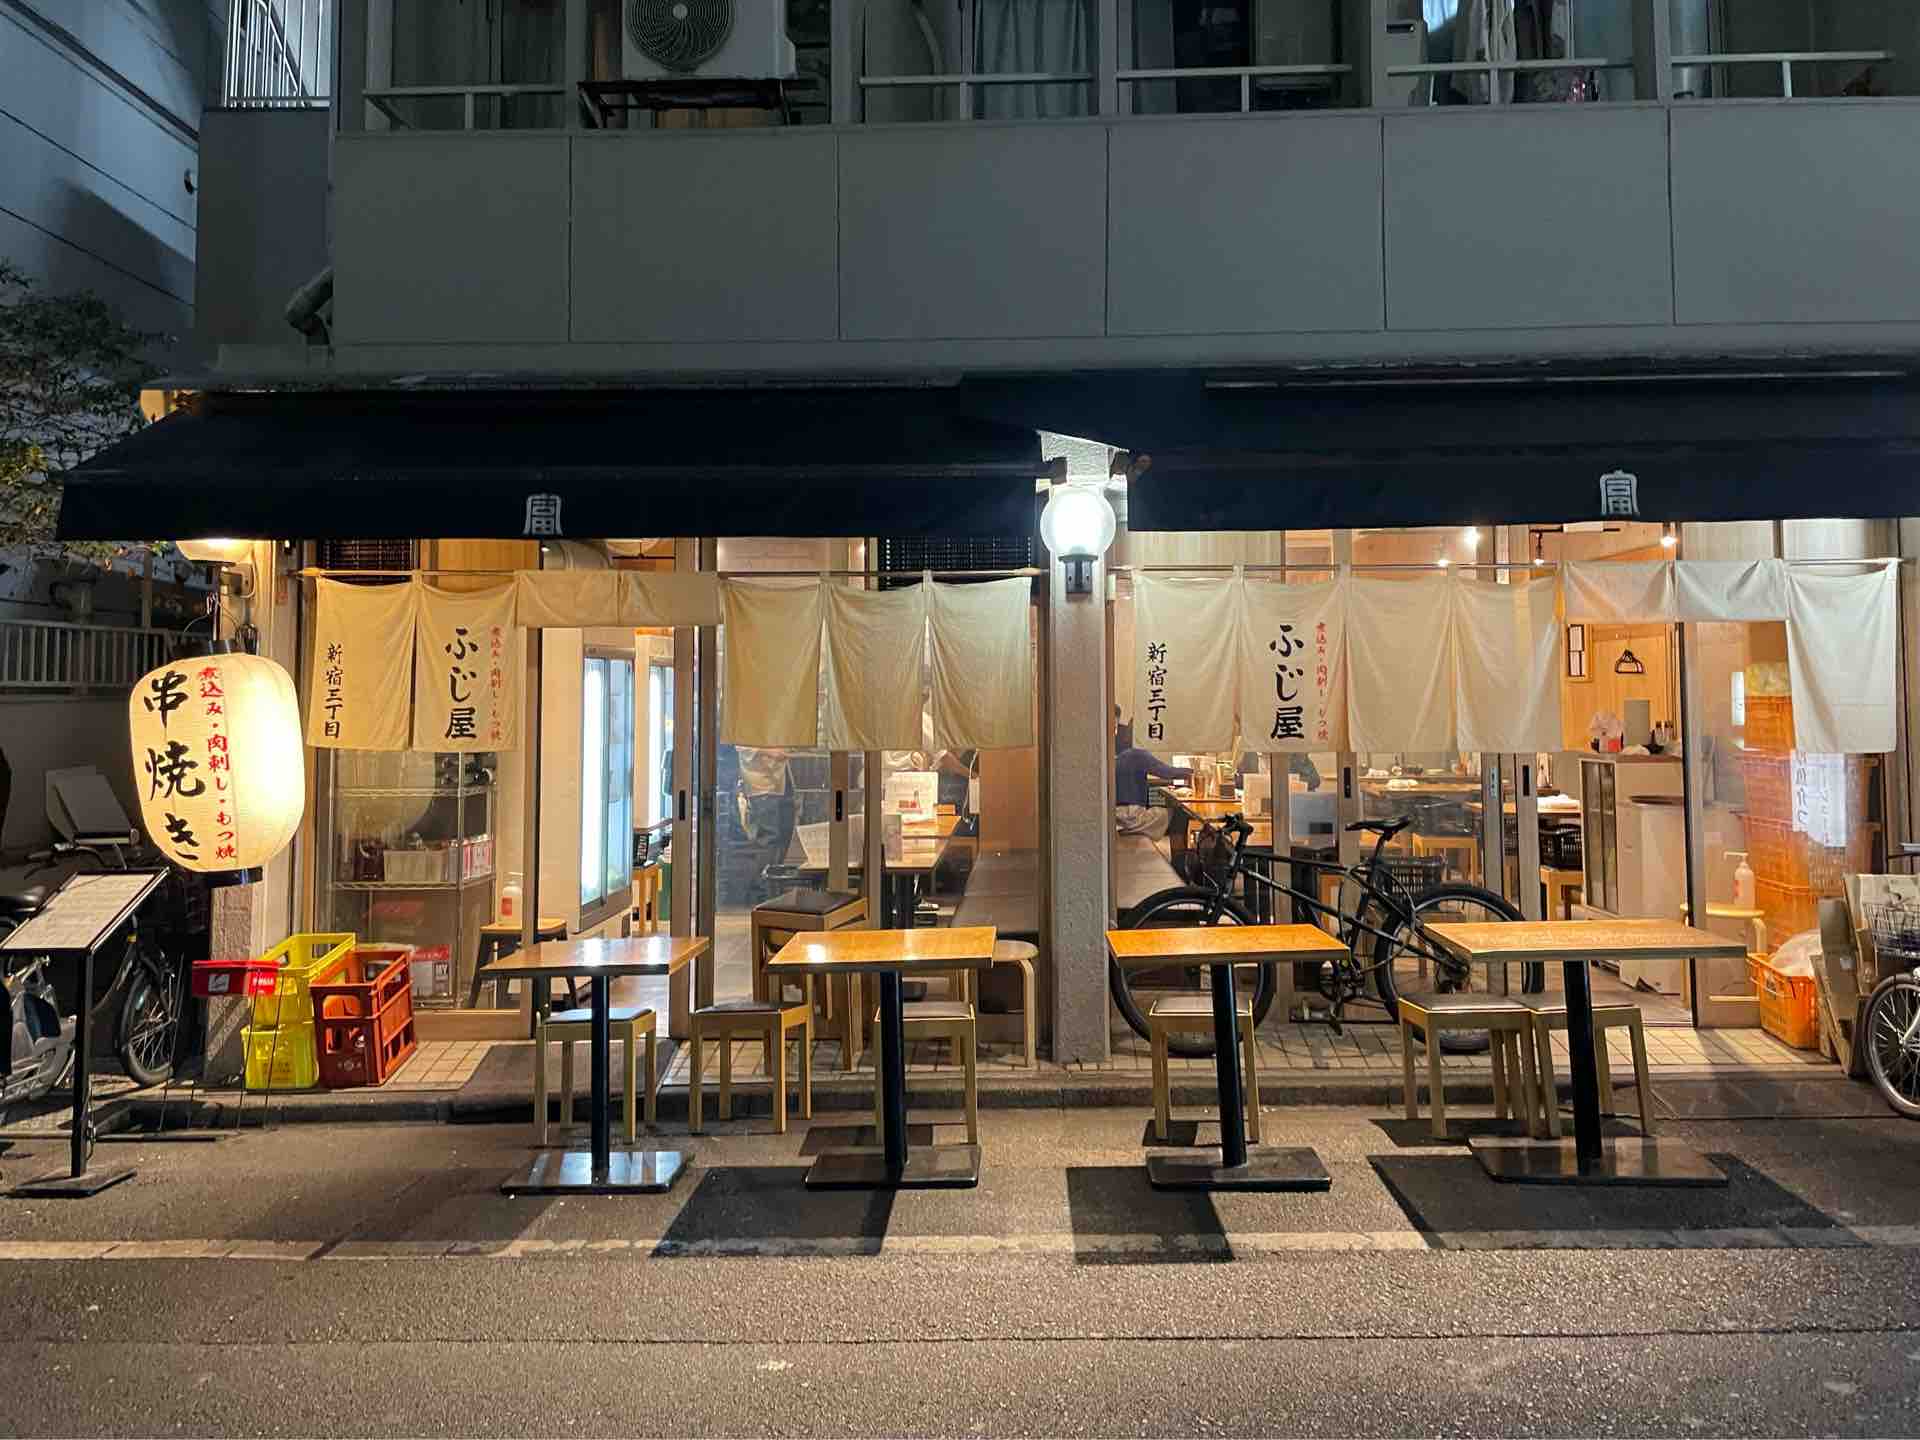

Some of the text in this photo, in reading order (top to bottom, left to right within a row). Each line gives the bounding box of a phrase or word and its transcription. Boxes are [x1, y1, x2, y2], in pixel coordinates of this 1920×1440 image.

[325, 643, 343, 738] 新宿三丁目
[444, 627, 479, 739] ふじ屋
[1147, 642, 1167, 741] 新宿三丁目
[1270, 624, 1304, 739] ふじ屋
[143, 670, 206, 860] 串焼き
